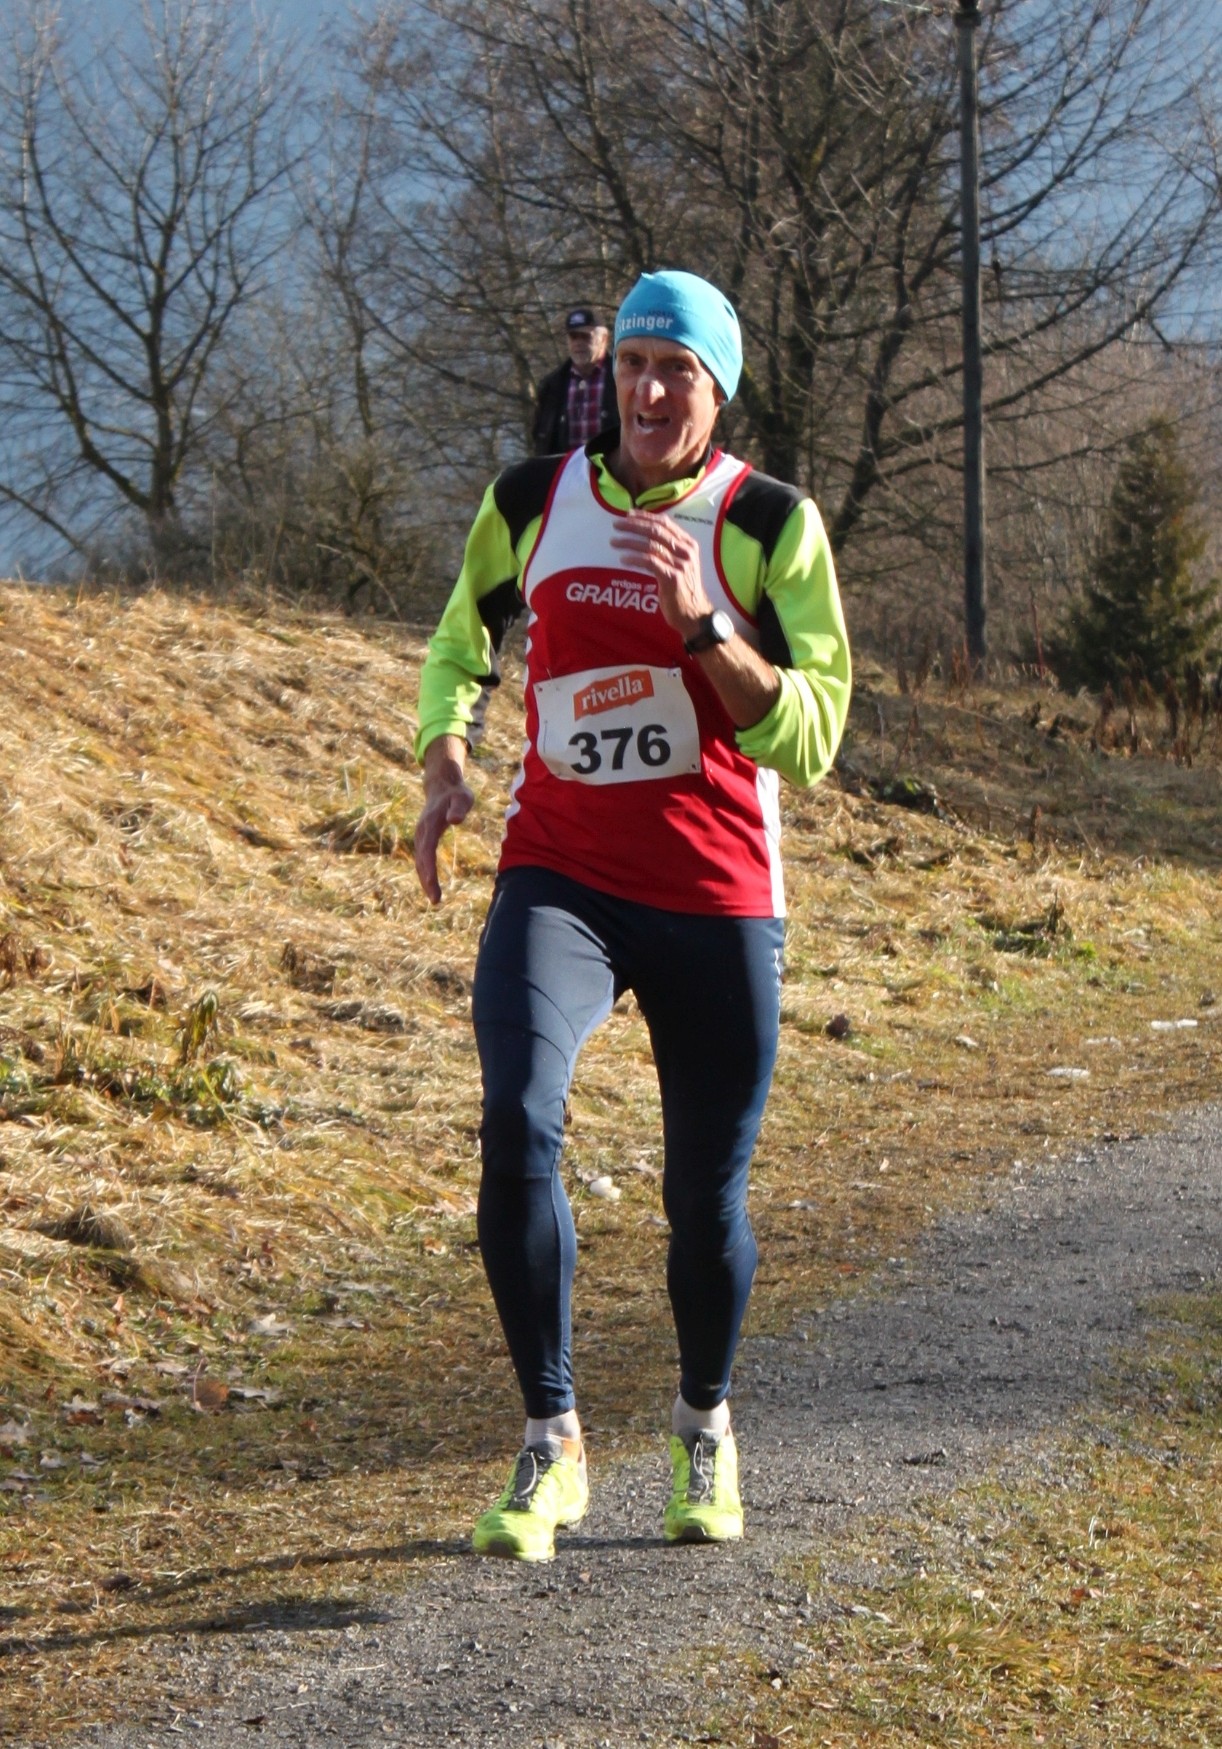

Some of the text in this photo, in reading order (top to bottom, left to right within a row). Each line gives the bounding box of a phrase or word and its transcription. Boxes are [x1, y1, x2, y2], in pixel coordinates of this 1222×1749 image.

[566, 582, 660, 613] GRAVAG
[611, 579, 641, 590] erdgas
[581, 675, 643, 710] rivella
[568, 724, 671, 775] 376
